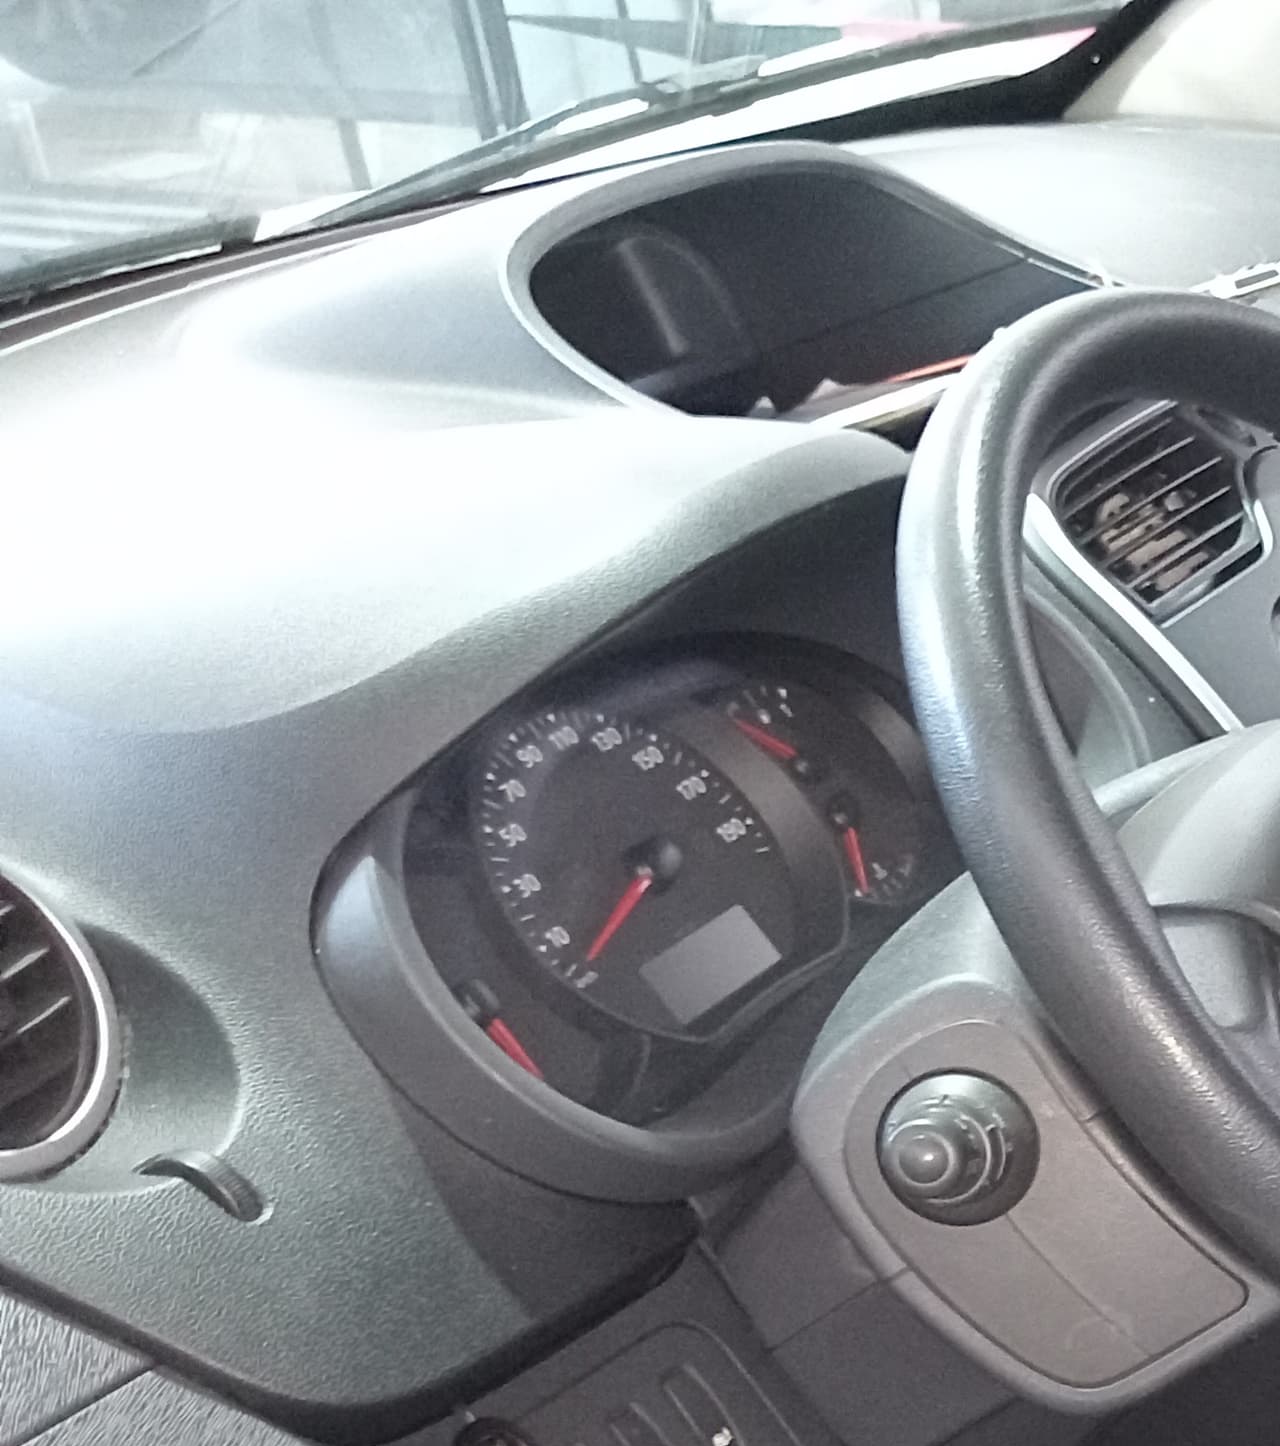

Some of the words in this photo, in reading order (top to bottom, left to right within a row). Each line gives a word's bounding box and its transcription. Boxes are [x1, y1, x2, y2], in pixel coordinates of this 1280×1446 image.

[516, 744, 543, 768] 90
[498, 779, 526, 803] 70
[499, 823, 527, 847] 50
[512, 873, 541, 898] 30
